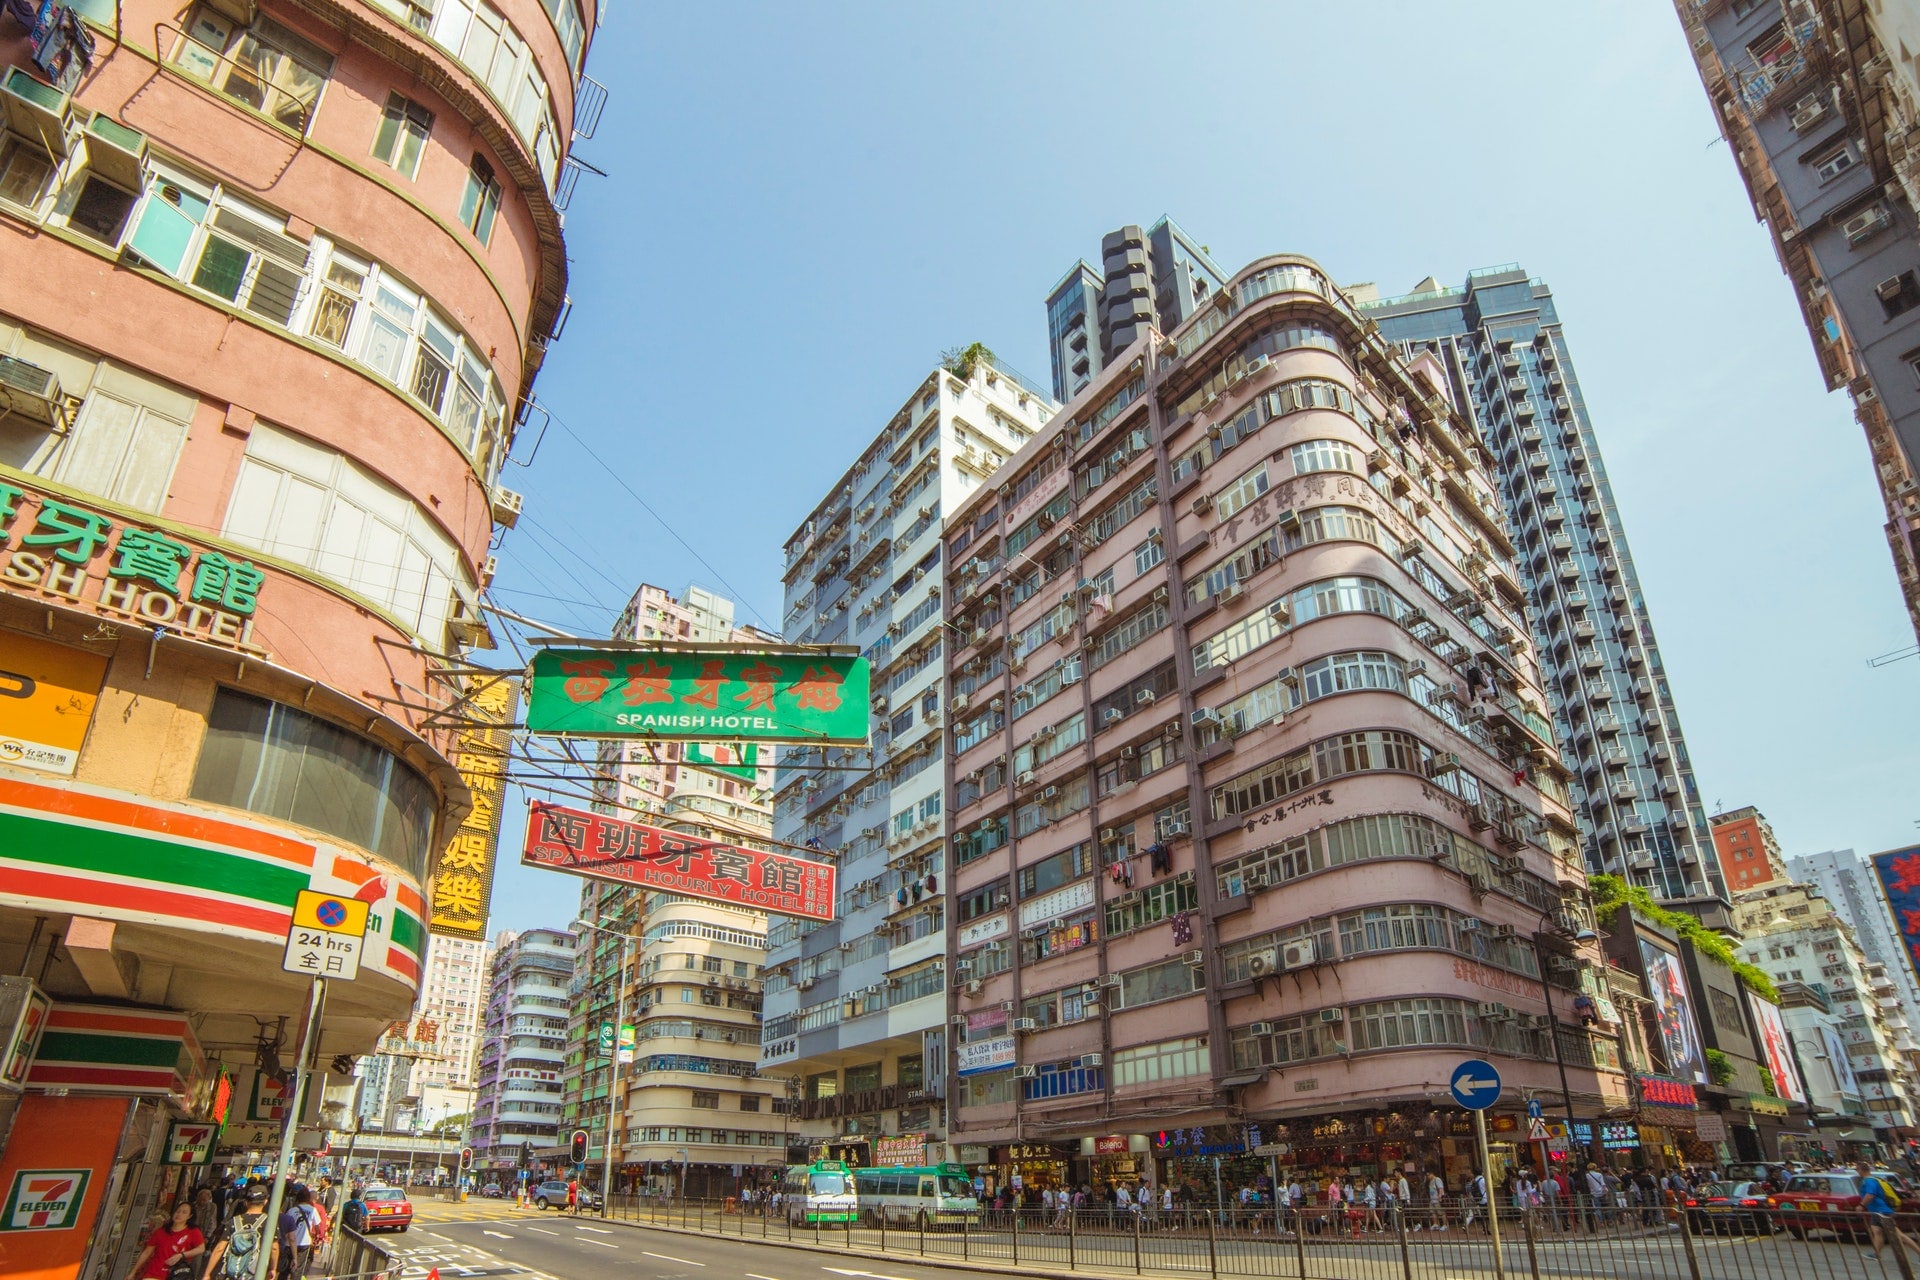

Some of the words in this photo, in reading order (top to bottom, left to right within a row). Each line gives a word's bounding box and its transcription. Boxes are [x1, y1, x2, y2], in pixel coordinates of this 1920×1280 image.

[99, 576, 263, 650] HOTEL
[616, 713, 705, 728] SPANISH
[710, 715, 778, 730] HOTEL
[539, 808, 806, 896] 西班牙賓館
[533, 846, 633, 878] SPANISH
[645, 869, 731, 896] HOURLY
[740, 888, 804, 911] HOTEL
[298, 933, 321, 948] 24
[326, 937, 353, 953] hrs
[299, 952, 343, 973] 全日
[1100, 1141, 1123, 1150] Baleno
